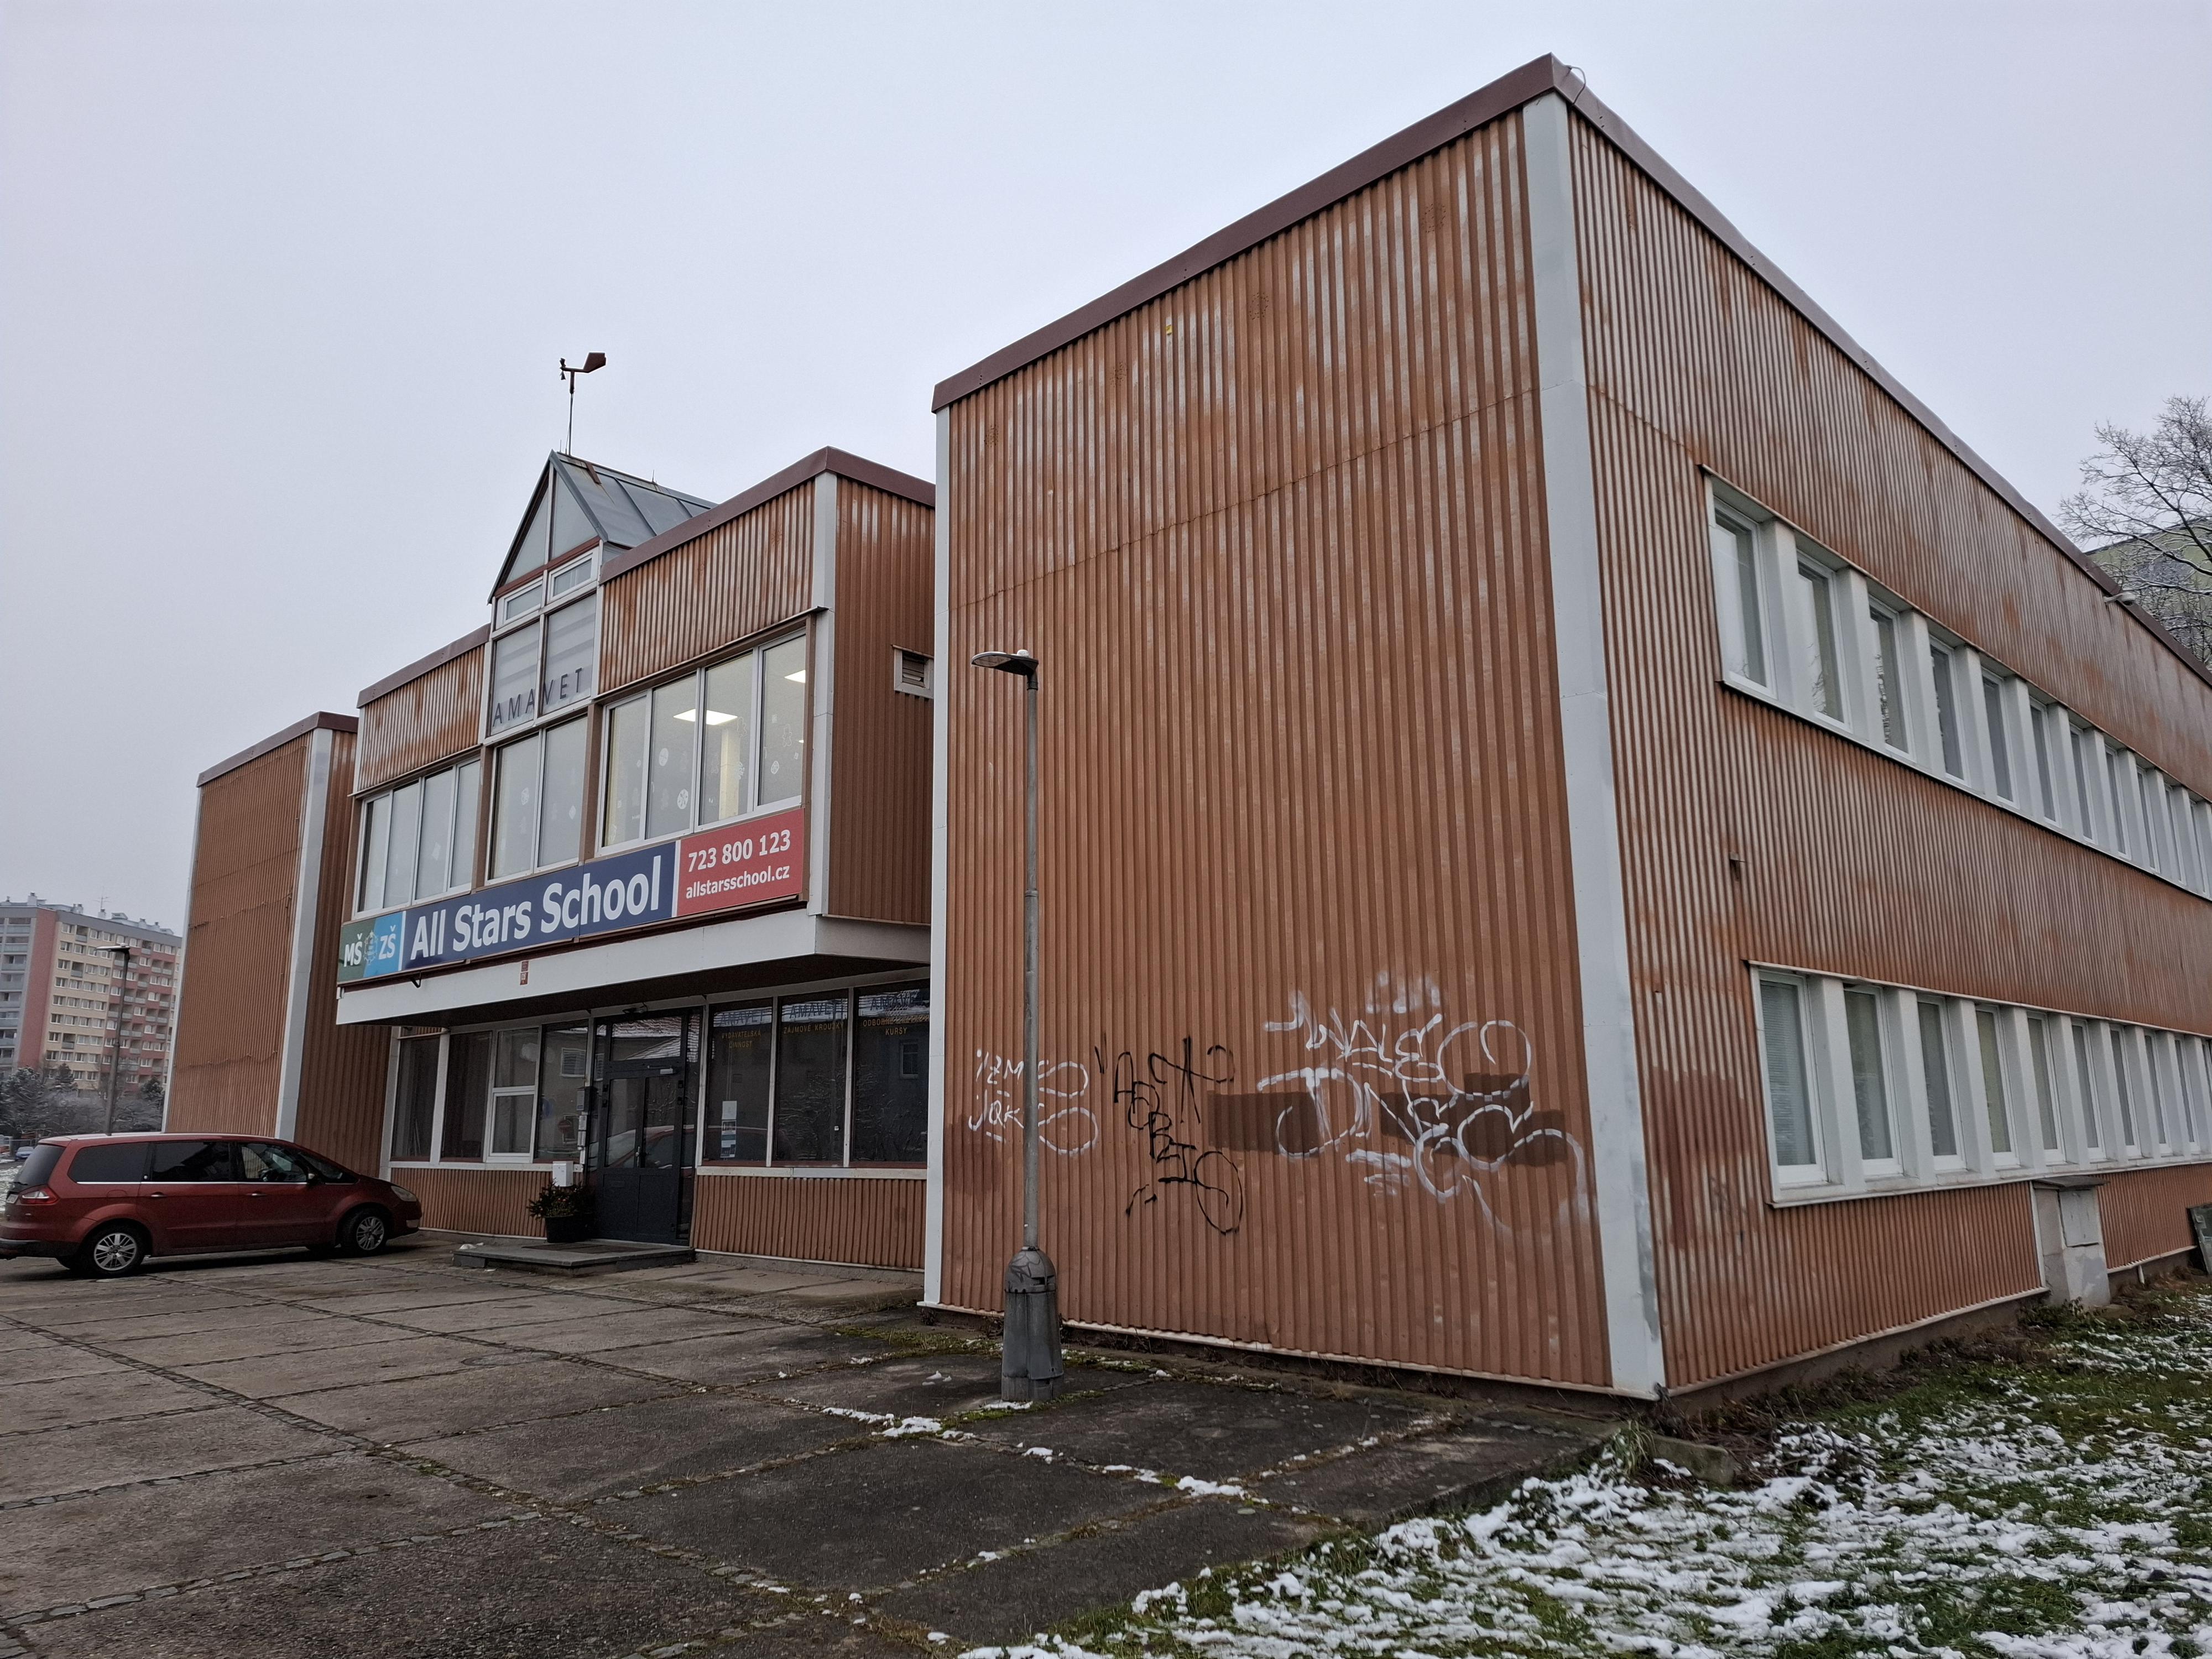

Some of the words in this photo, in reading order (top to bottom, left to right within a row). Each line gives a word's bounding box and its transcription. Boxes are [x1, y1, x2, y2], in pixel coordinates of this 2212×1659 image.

[492, 667, 582, 727] AMAVET
[688, 847, 717, 873] 723
[722, 838, 753, 864] 800
[759, 829, 791, 857] 123
[686, 865, 790, 899] allstarsschool.cz
[410, 909, 446, 960] All
[452, 901, 532, 952] Stars
[540, 855, 661, 933] School
[343, 932, 363, 968] MŠ
[378, 924, 397, 960] ZŠ
[885, 1026, 907, 1036] KURSY
